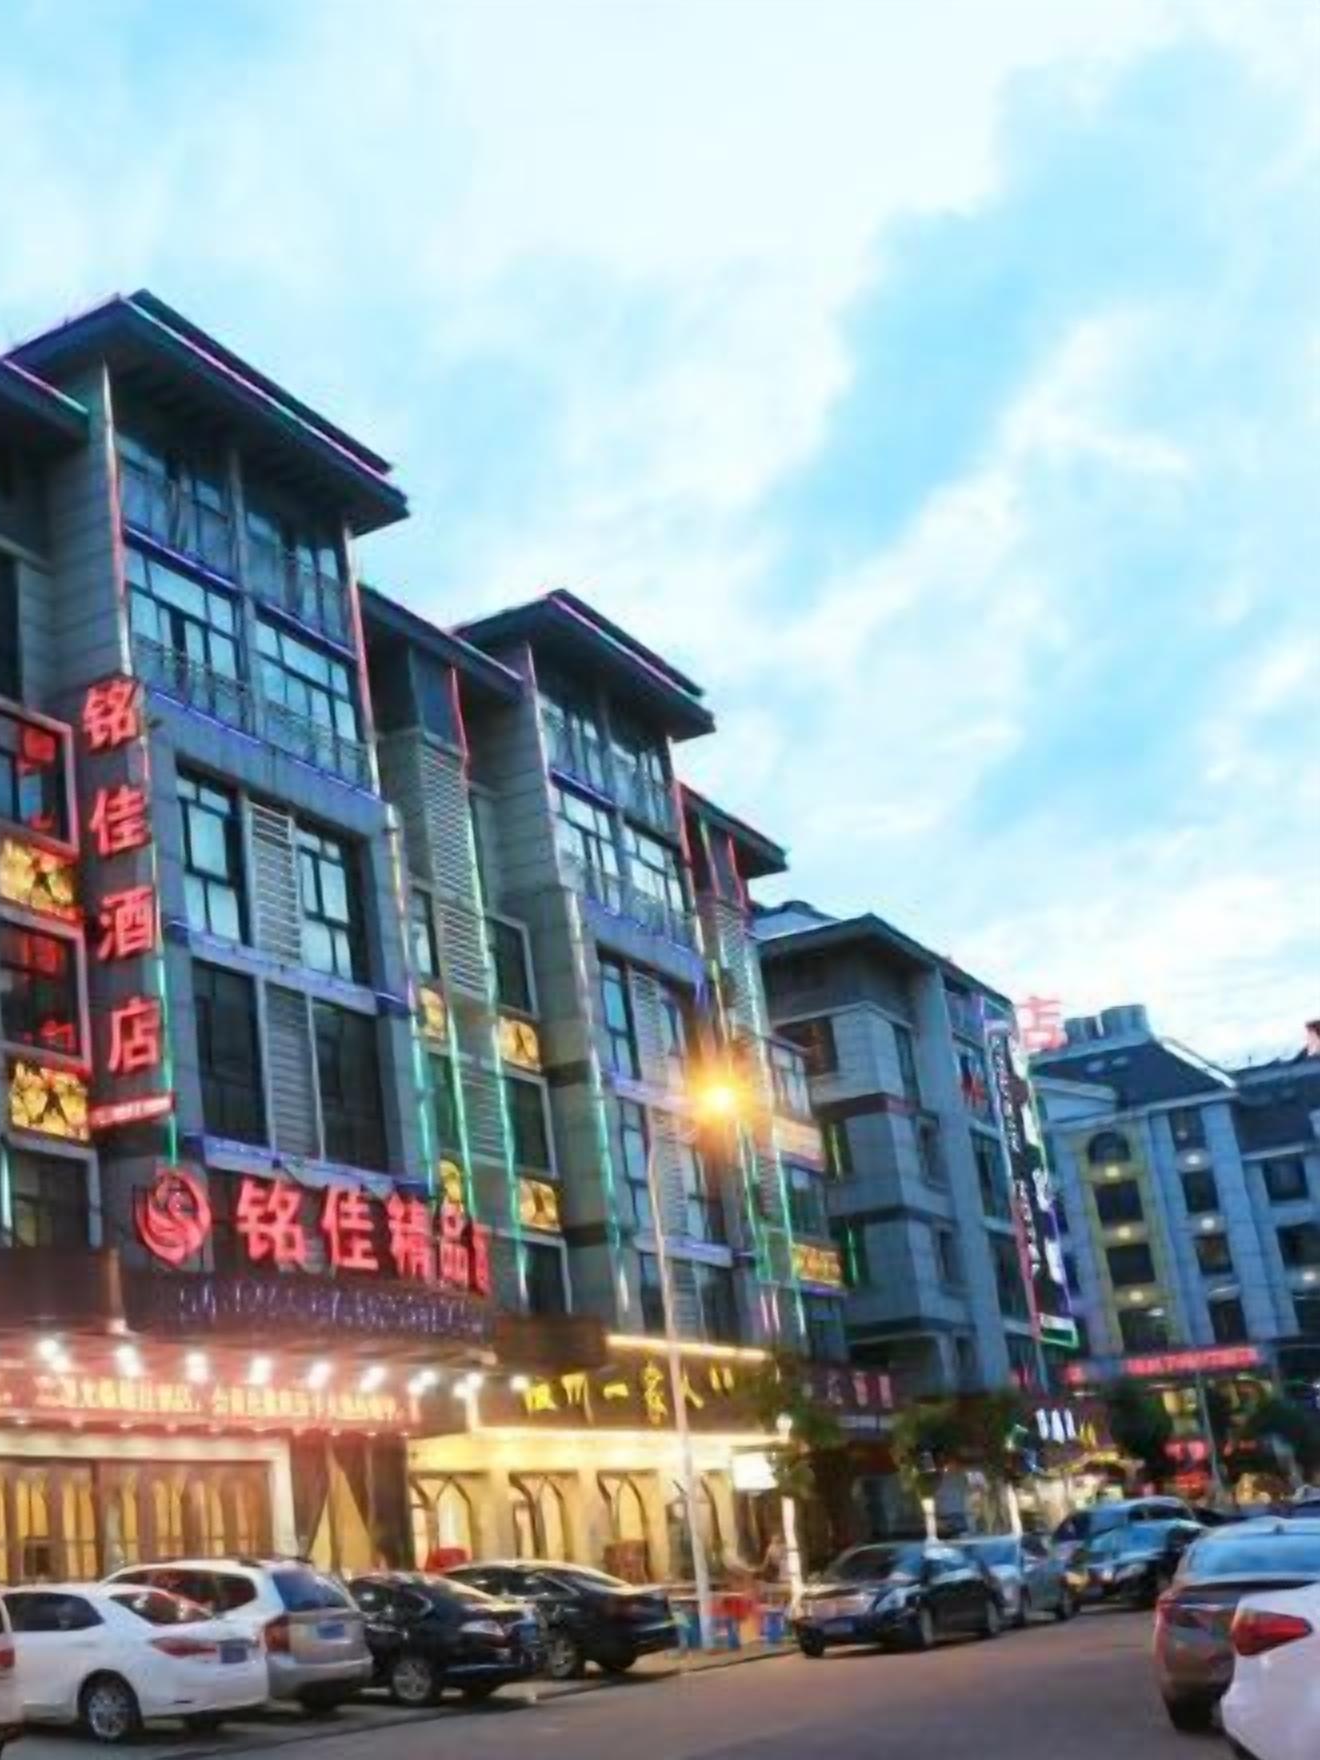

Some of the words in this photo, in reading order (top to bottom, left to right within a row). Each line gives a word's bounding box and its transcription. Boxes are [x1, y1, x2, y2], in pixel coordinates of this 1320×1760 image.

[82, 678, 160, 1074] 铭佳酒店
[236, 1172, 494, 1298] 铭佳精品
